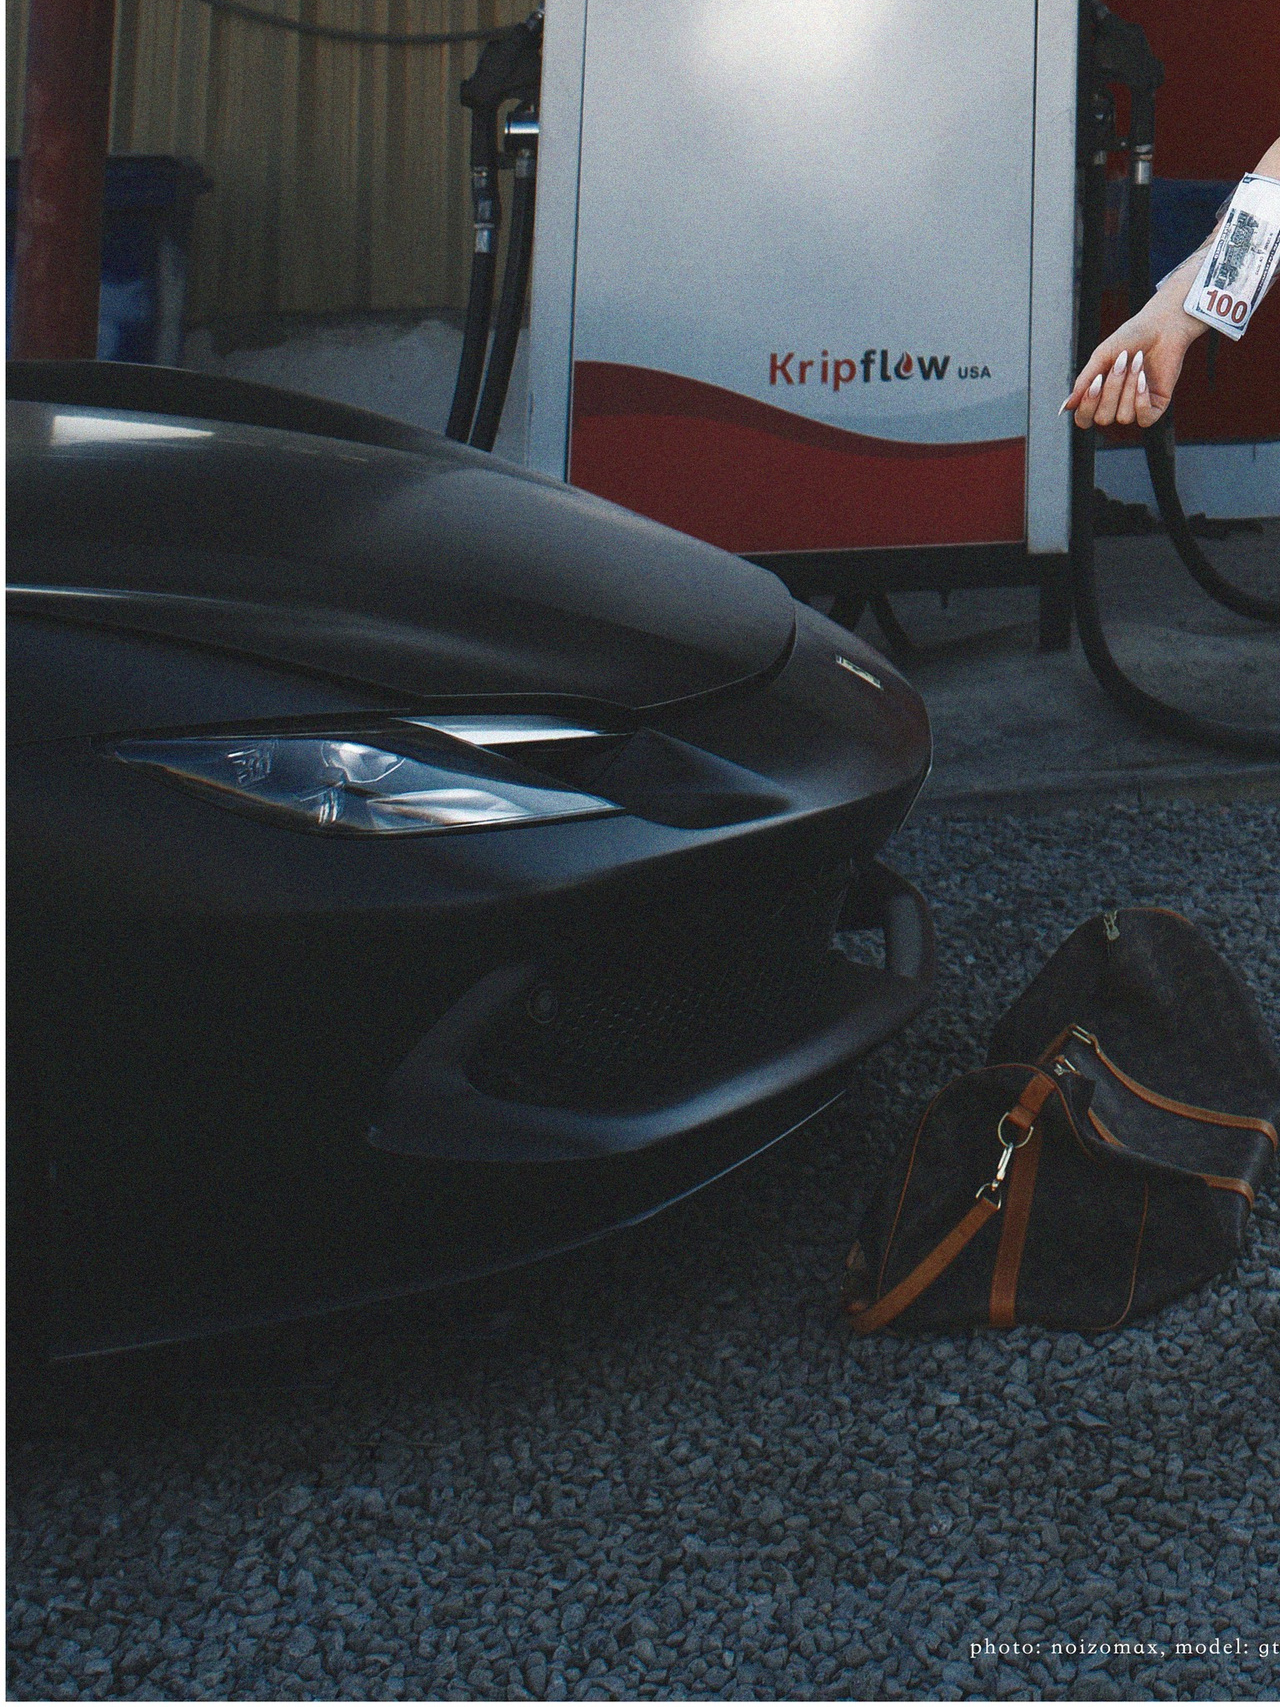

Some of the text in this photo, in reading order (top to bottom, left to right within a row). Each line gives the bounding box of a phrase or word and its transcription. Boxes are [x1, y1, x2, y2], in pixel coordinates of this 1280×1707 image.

[1206, 289, 1249, 324] 100
[769, 349, 992, 392] Kripflow USA
